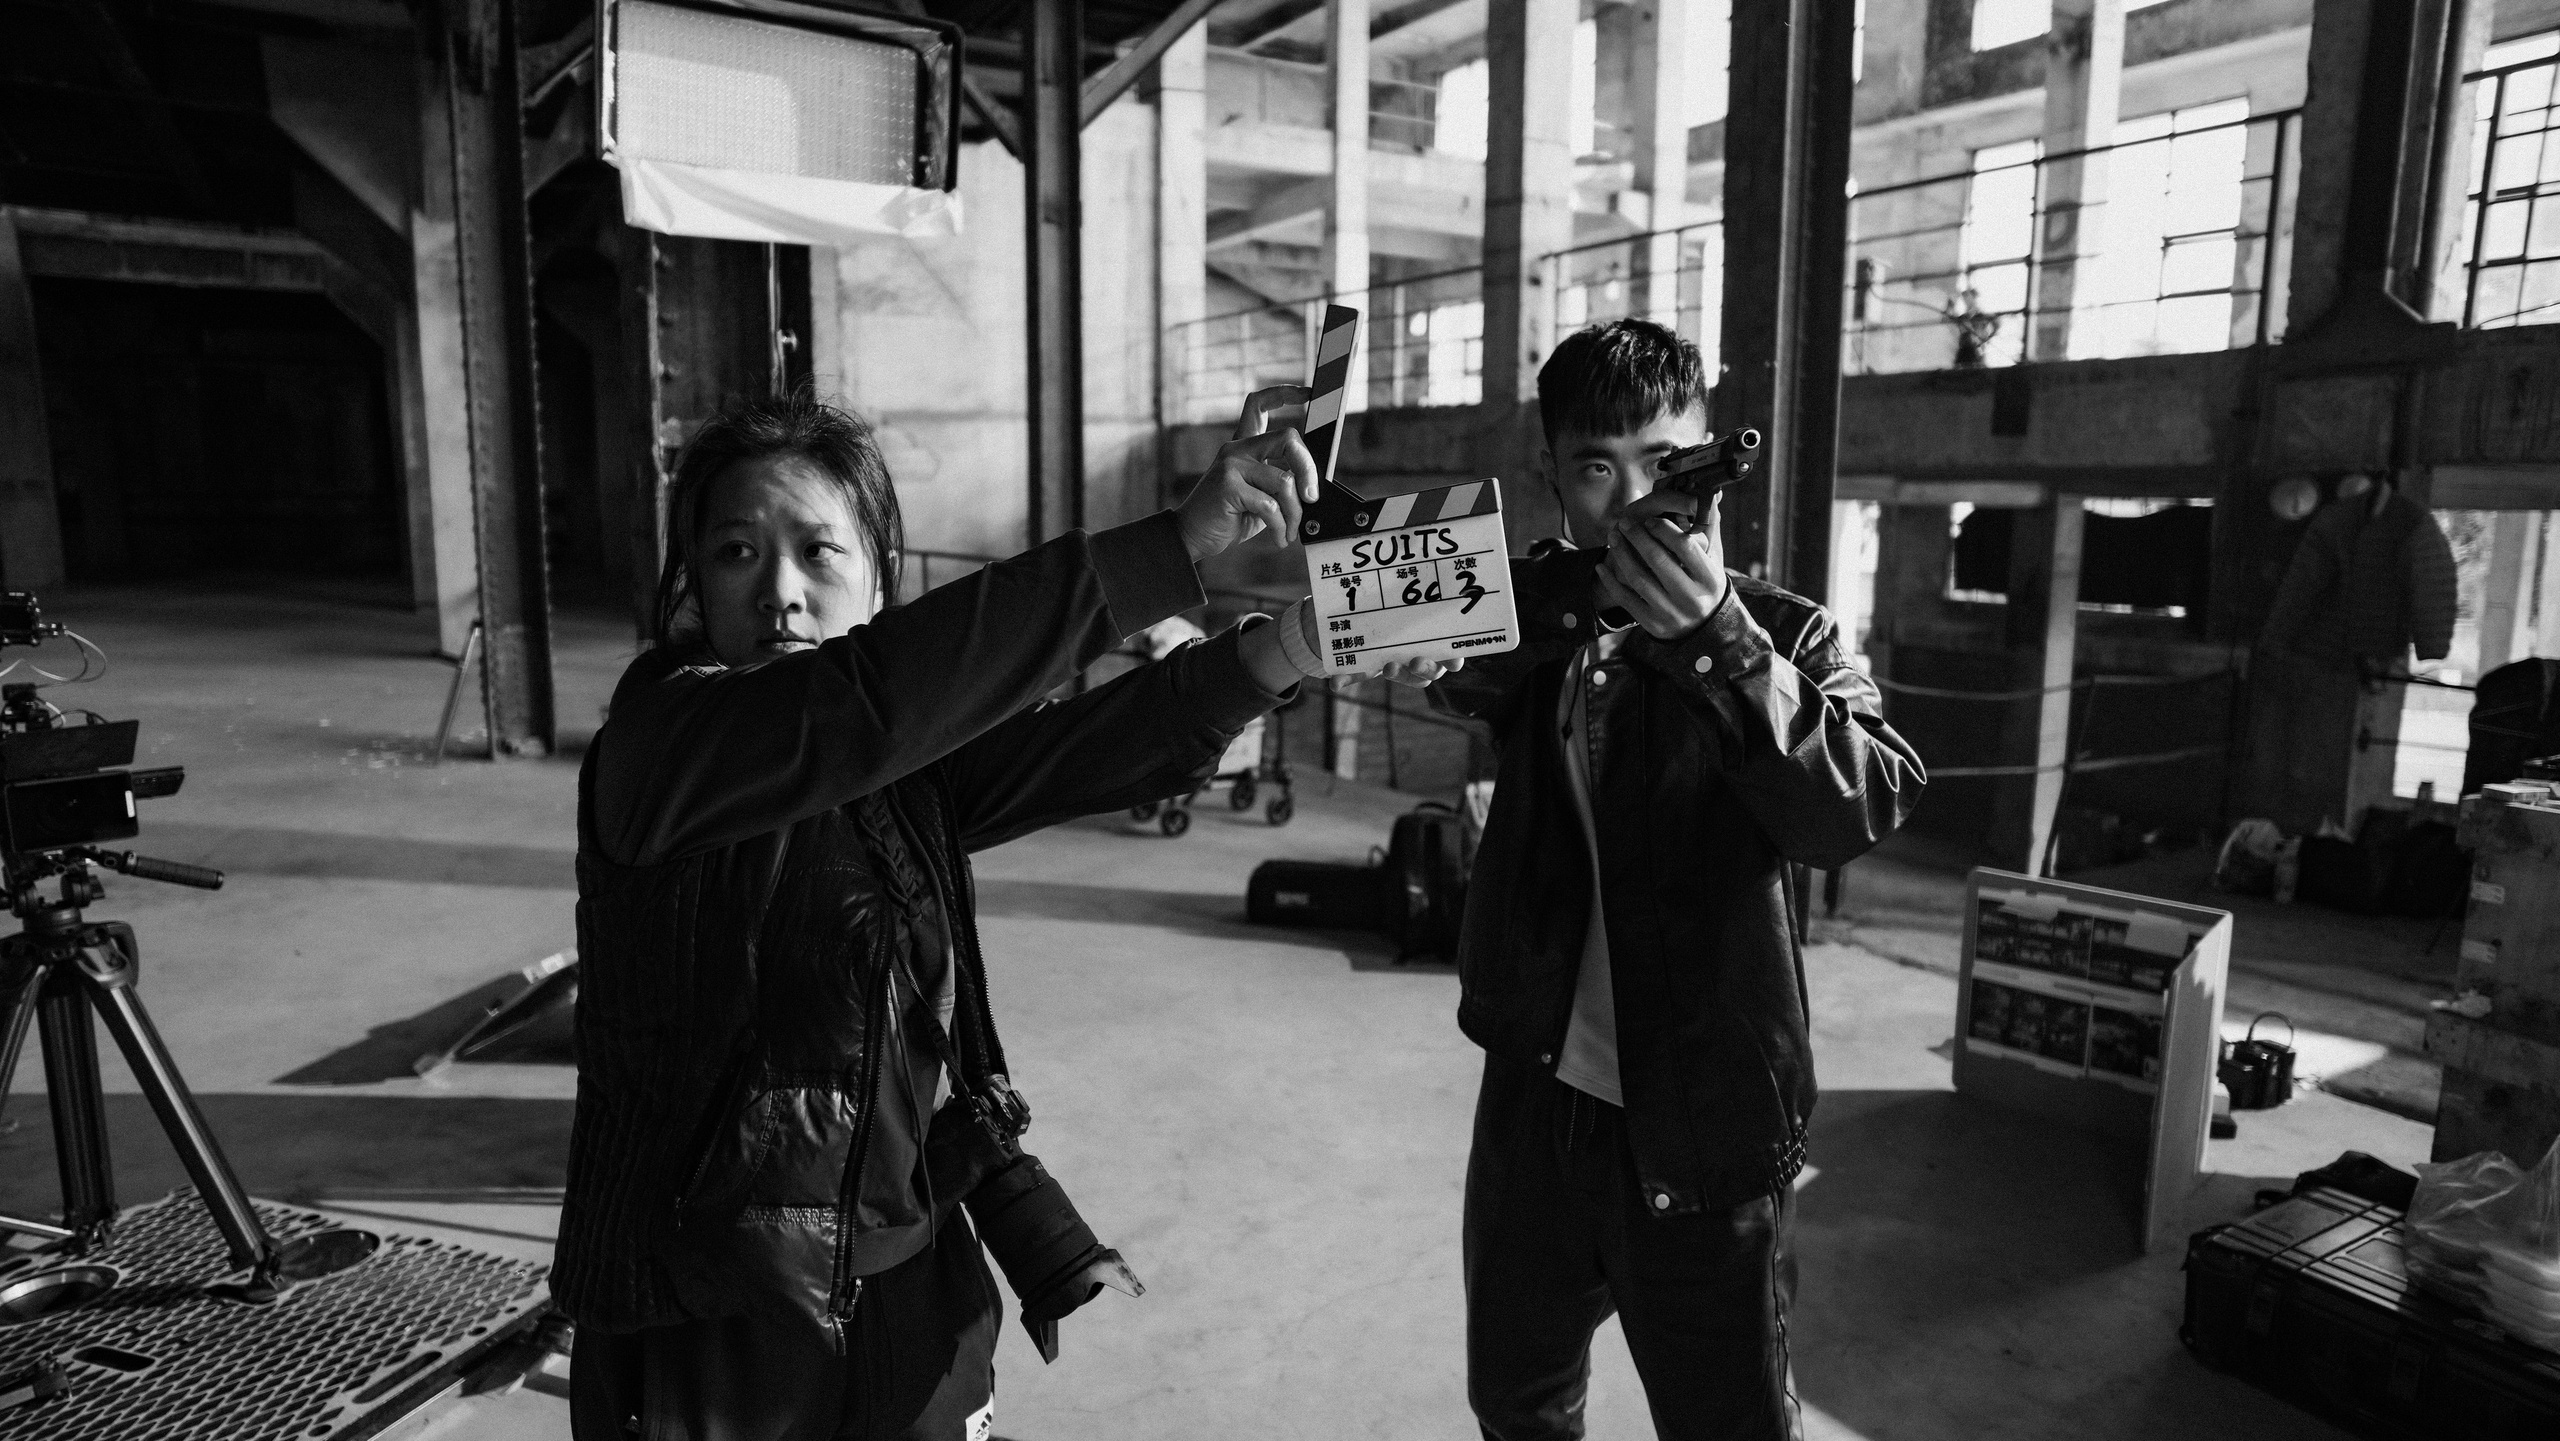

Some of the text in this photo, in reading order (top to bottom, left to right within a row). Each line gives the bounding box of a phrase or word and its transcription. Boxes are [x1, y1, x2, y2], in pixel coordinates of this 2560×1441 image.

[1351, 528, 1459, 569] SUITS
[1321, 562, 1342, 576] 片名
[1454, 557, 1478, 571] 次数
[1396, 566, 1419, 579] 场号
[1340, 575, 1362, 589] 卷号
[1346, 587, 1357, 611] 1
[1329, 619, 1352, 632] 导演
[1331, 635, 1365, 650] 摄影师
[1335, 654, 1357, 667] 日期
